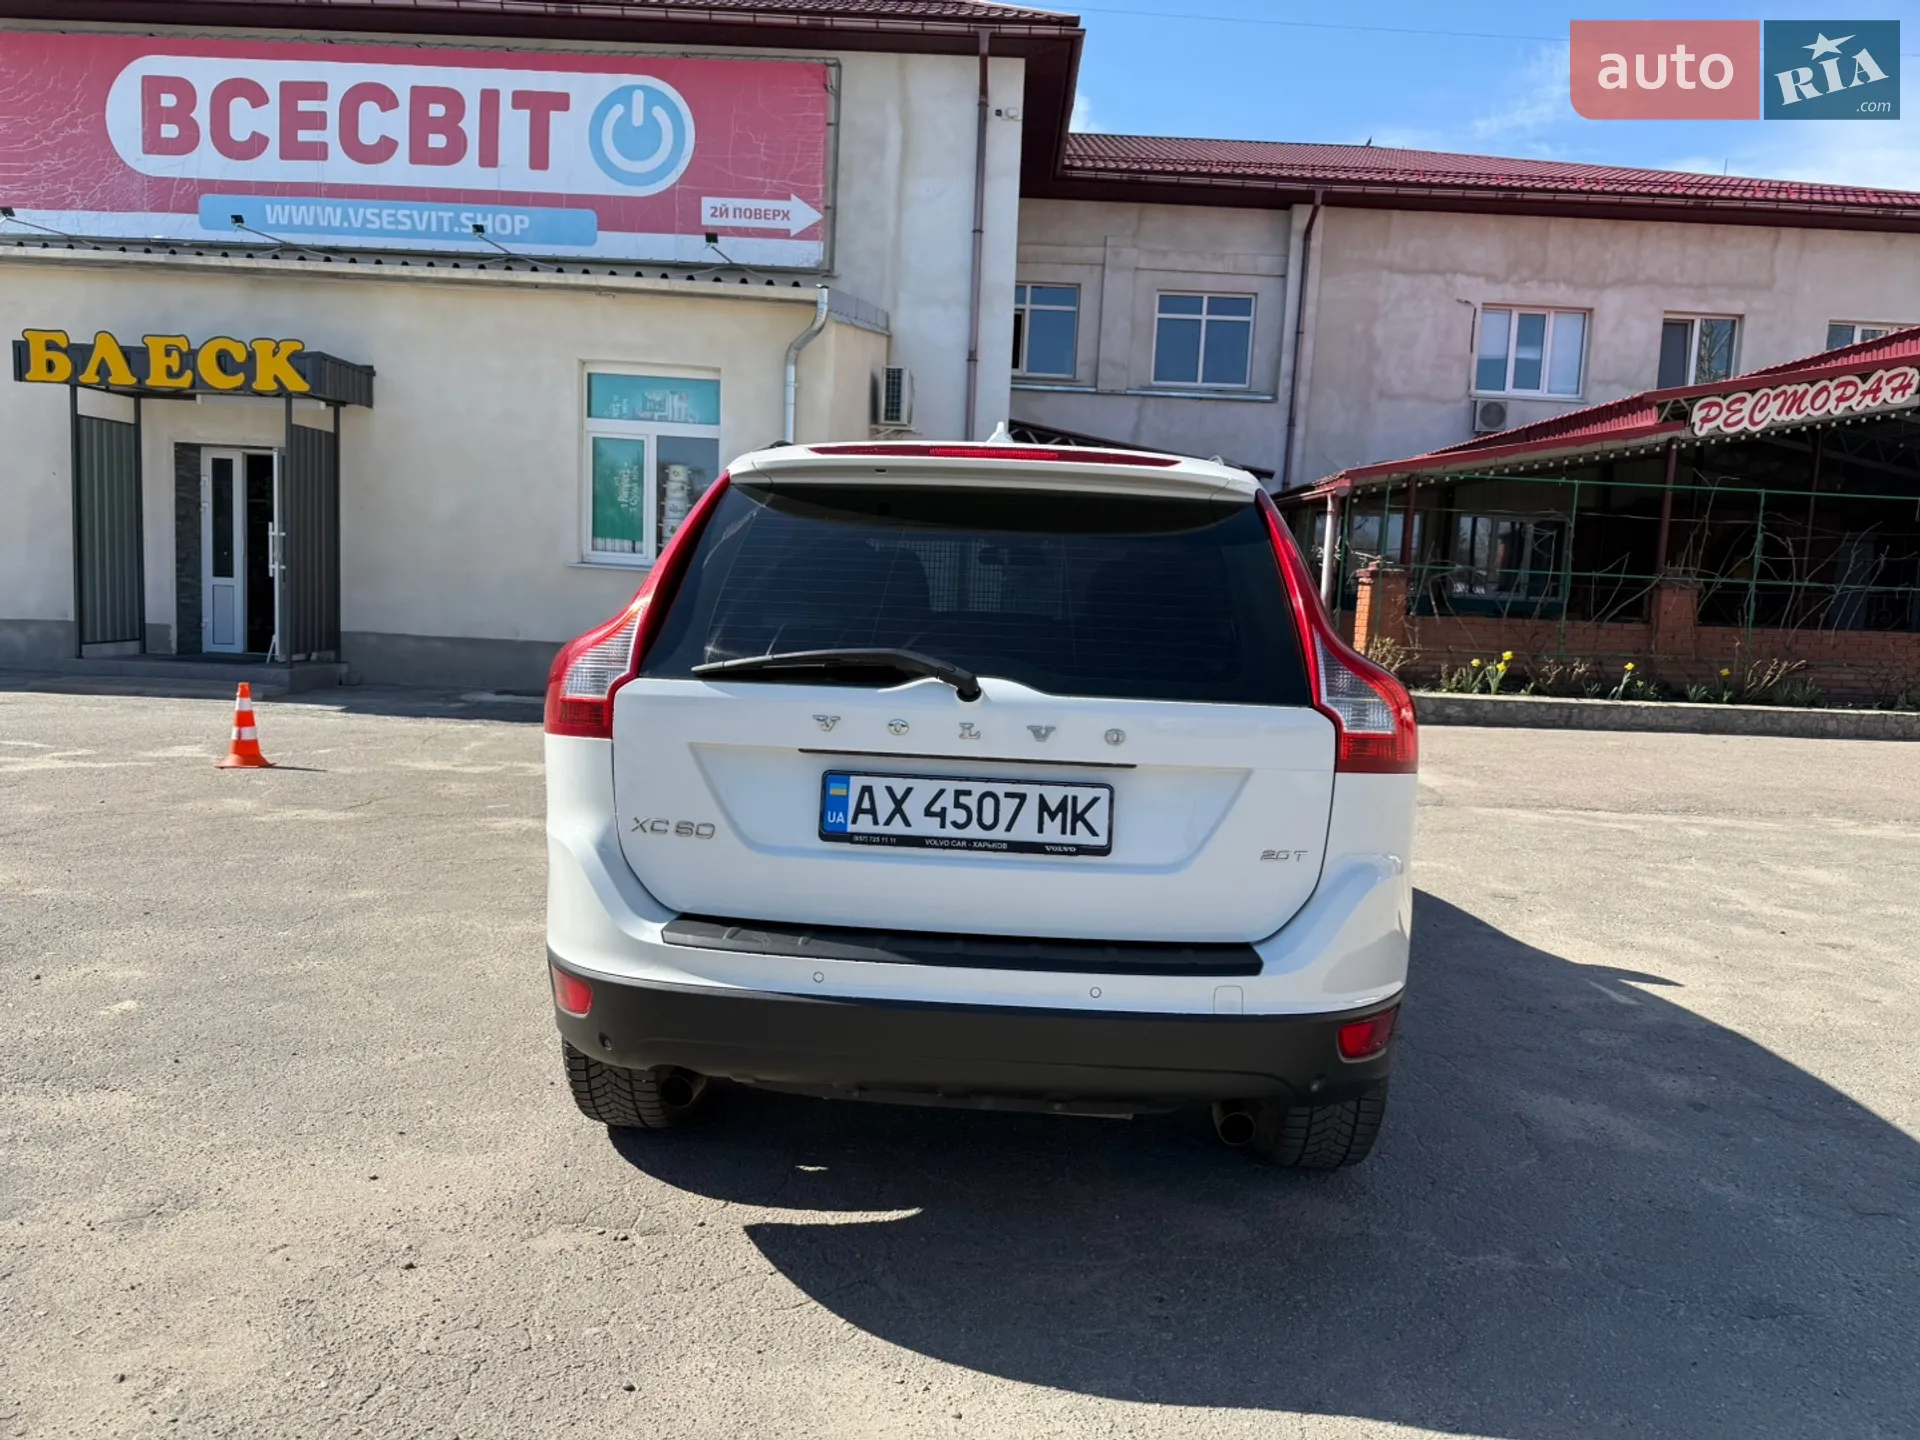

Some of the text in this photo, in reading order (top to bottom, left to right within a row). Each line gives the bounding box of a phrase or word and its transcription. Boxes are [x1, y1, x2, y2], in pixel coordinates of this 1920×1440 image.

[140, 74, 571, 171] ВСЕСВІТ
[264, 203, 531, 236] WWW.VSESVIT.SHOP
[710, 203, 791, 221] 2Й ПОВЕРХ
[22, 329, 311, 392] БЛЕСК
[1696, 370, 1916, 432] РЕСТОРАН
[812, 714, 1126, 746] VOLVO
[827, 810, 846, 825] UA
[851, 785, 1102, 838] AX 4507 MK
[925, 838, 950, 847] VOLVO
[951, 840, 967, 848] CAR
